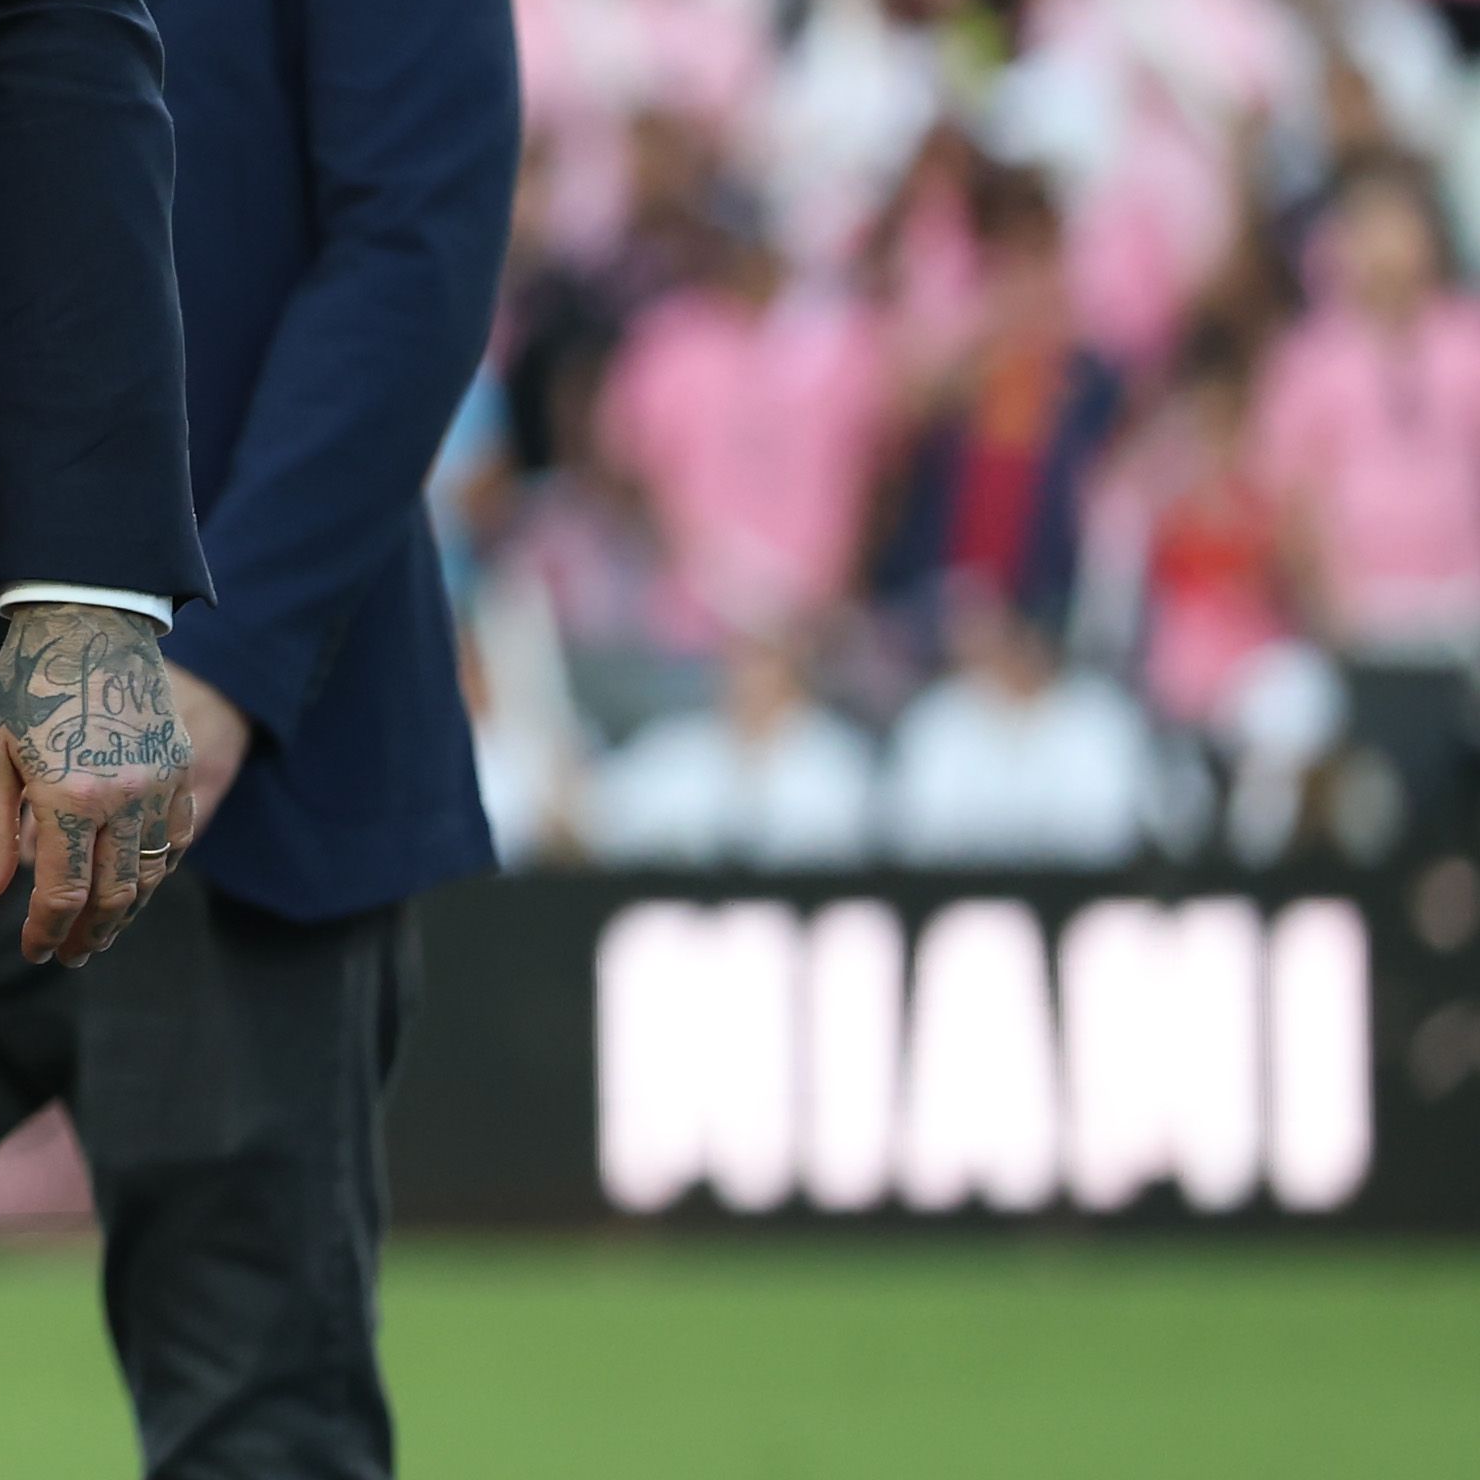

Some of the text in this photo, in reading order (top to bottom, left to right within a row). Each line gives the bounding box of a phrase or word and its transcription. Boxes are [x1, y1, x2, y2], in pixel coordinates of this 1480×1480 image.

[45, 631, 172, 731] Love
[43, 726, 126, 784] Lead
[594, 896, 1374, 1216] MIAMI
